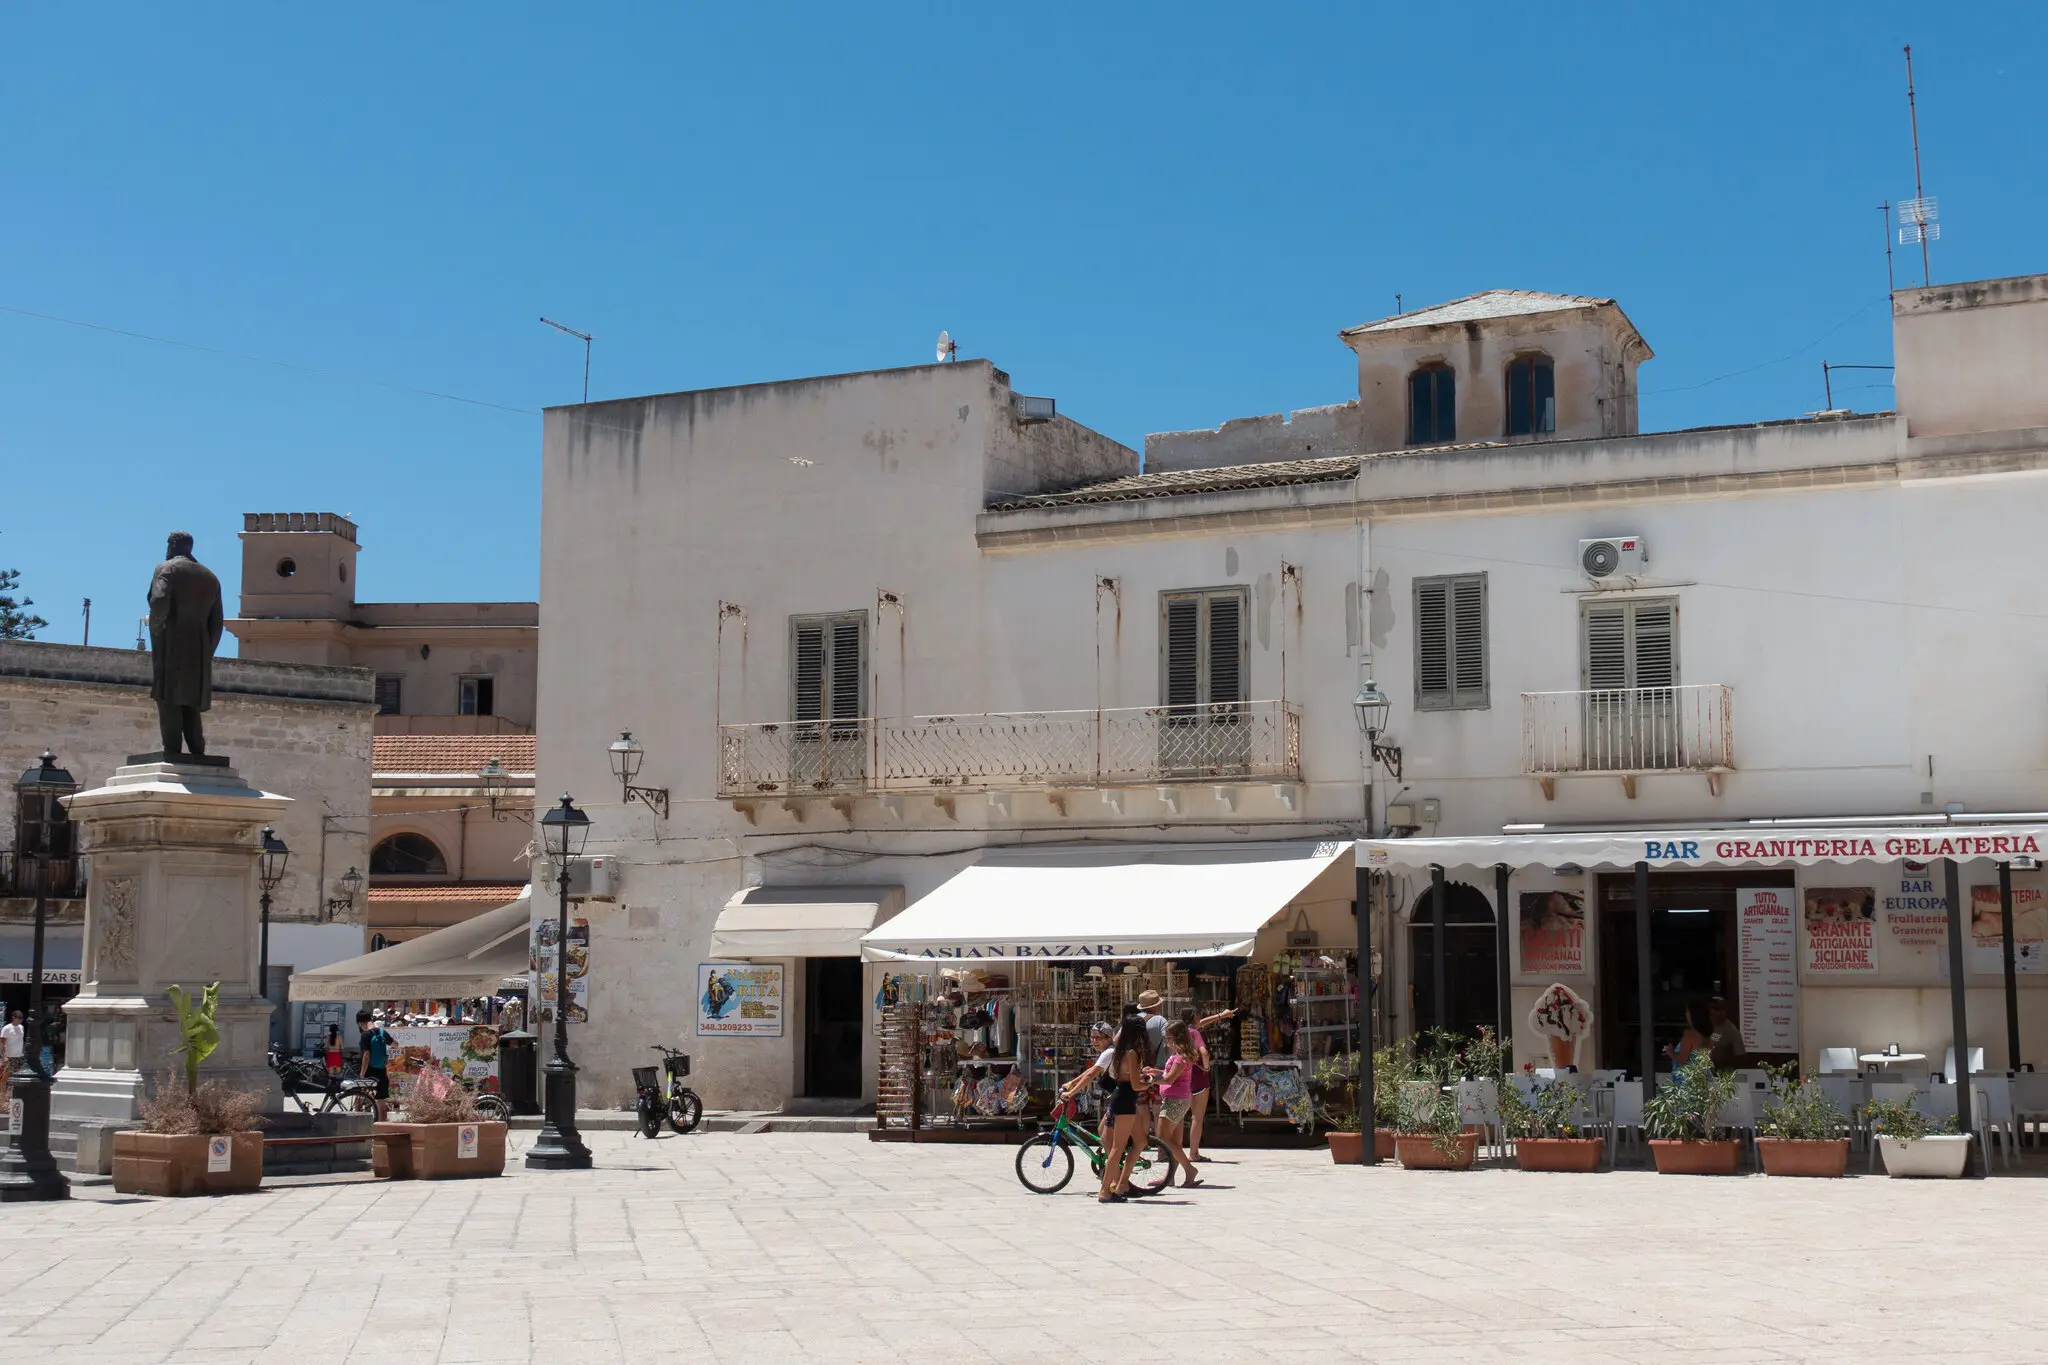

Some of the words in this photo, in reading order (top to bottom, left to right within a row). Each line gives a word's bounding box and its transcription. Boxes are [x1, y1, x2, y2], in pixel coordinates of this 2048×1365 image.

[1644, 841, 1700, 859] BAR
[1716, 839, 1876, 858] GRANITERIA
[1885, 835, 2040, 856] GELATERIA
[1901, 880, 1933, 893] BAR
[1754, 891, 1777, 904] TUTTO
[1885, 897, 1948, 910] EUROPA
[1744, 903, 1790, 917] ARTIGIANALE
[1887, 913, 1949, 924] Frullateria
[1809, 920, 1872, 938] GRANITE
[1892, 926, 1944, 935] Graniteria
[1523, 929, 1581, 949] GELATI
[1809, 938, 1873, 949] ARTIGIANALI
[919, 945, 1004, 958] ASIAN
[1016, 944, 1116, 957] BAZAR
[1815, 950, 1869, 963] SICILIANE
[13, 972, 23, 982] IL
[27, 972, 67, 982] BZAR
[728, 969, 780, 984] Noleggio
[737, 984, 779, 997] RITA
[700, 1023, 753, 1032] 348.3209233
